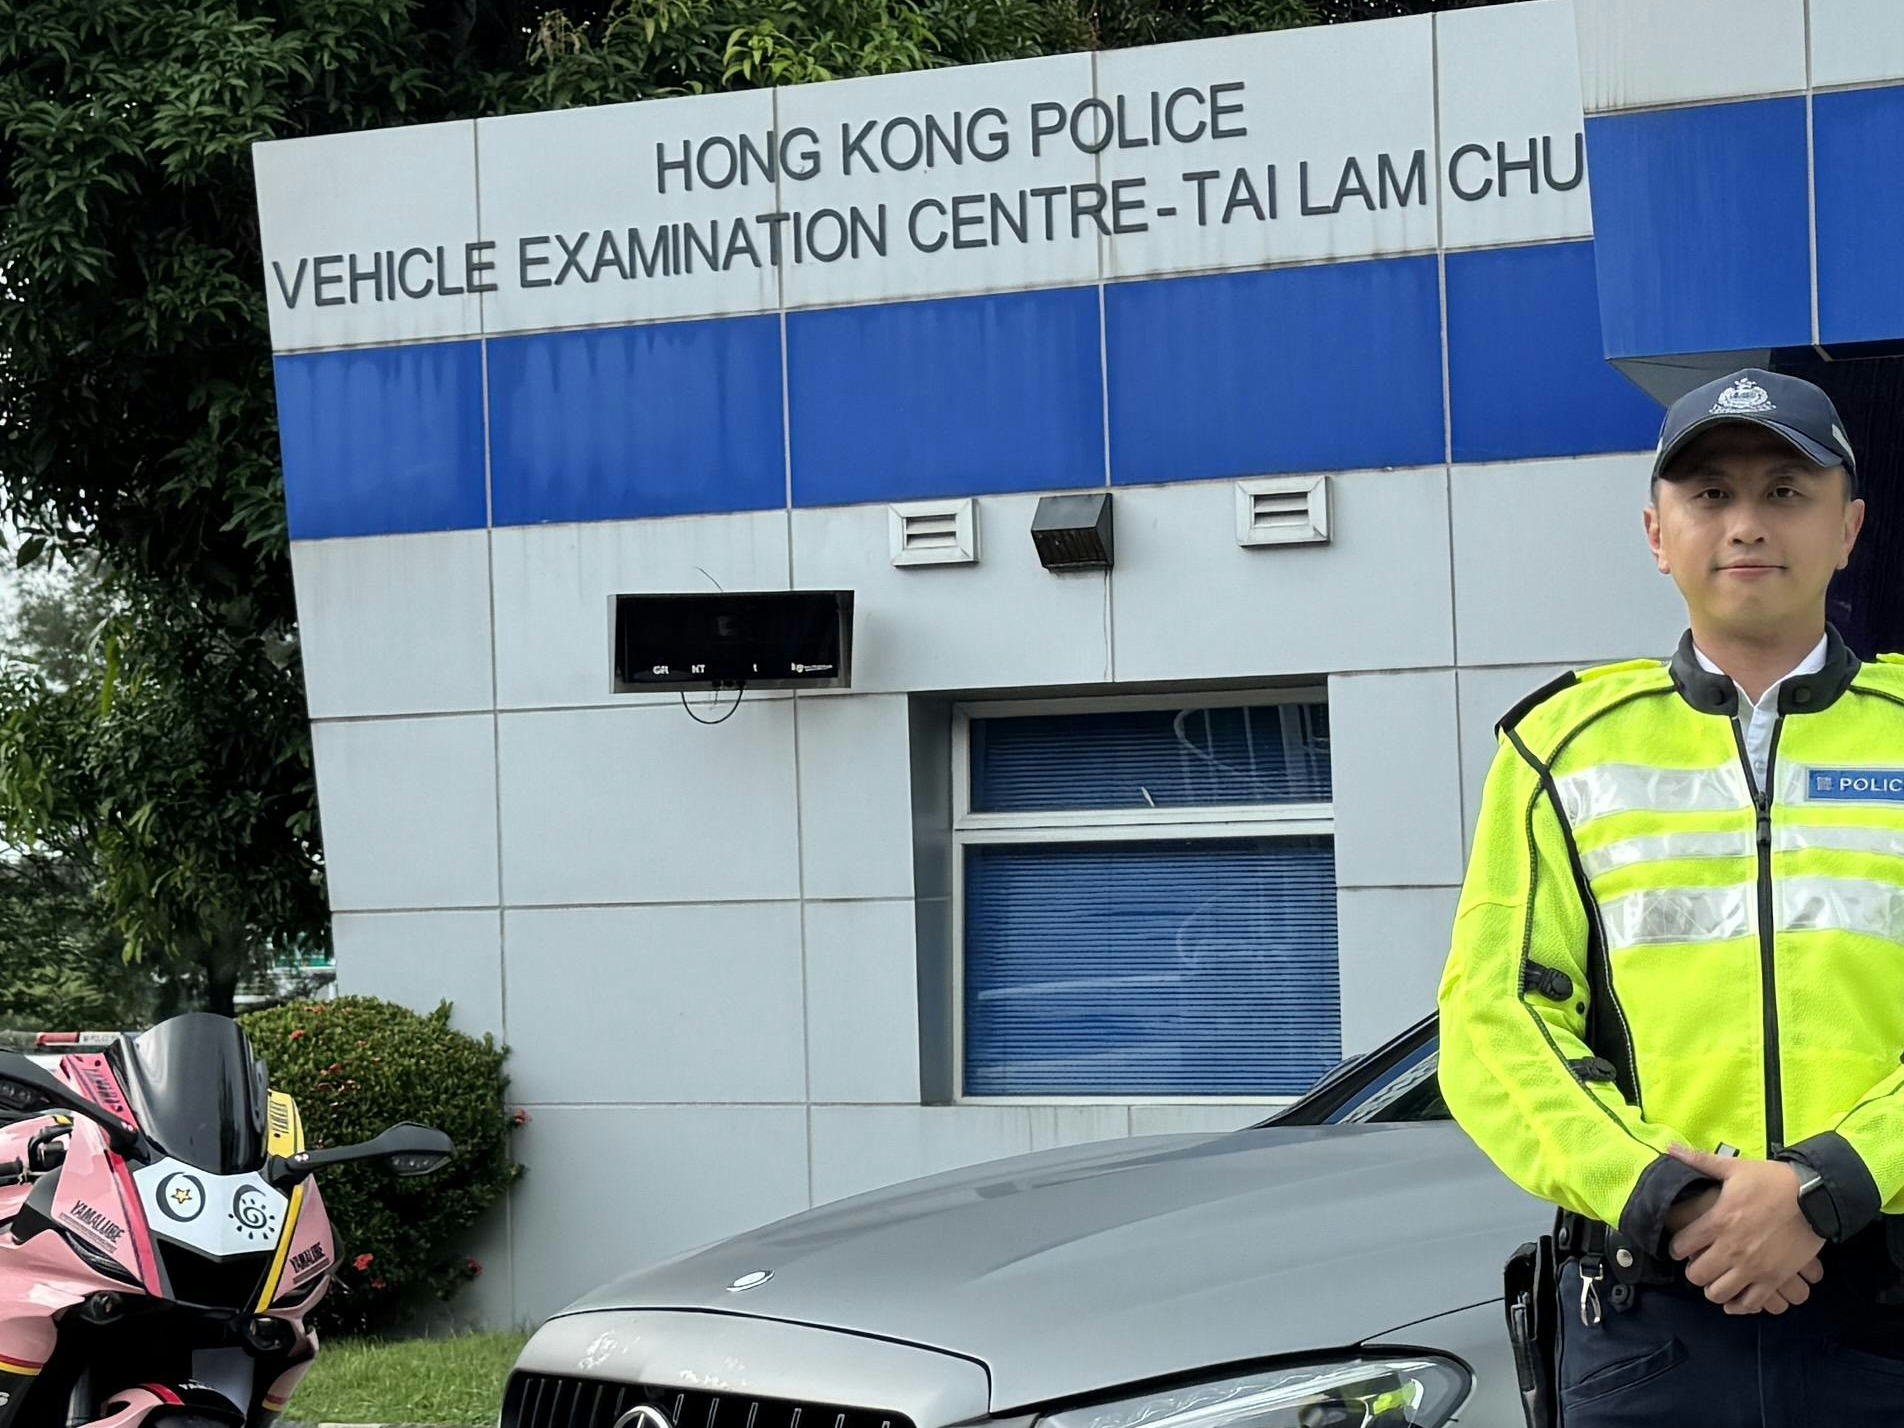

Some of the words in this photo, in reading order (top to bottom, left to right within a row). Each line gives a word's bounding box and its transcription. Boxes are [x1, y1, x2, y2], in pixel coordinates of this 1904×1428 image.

[656, 126, 821, 194] HONG
[842, 107, 1010, 174] KONG
[1031, 81, 1248, 157] POLICE
[272, 240, 498, 309] VEHICLE
[518, 203, 887, 288] EXAMINATION
[1298, 149, 1427, 217] LAM
[1448, 132, 1584, 201] CHU
